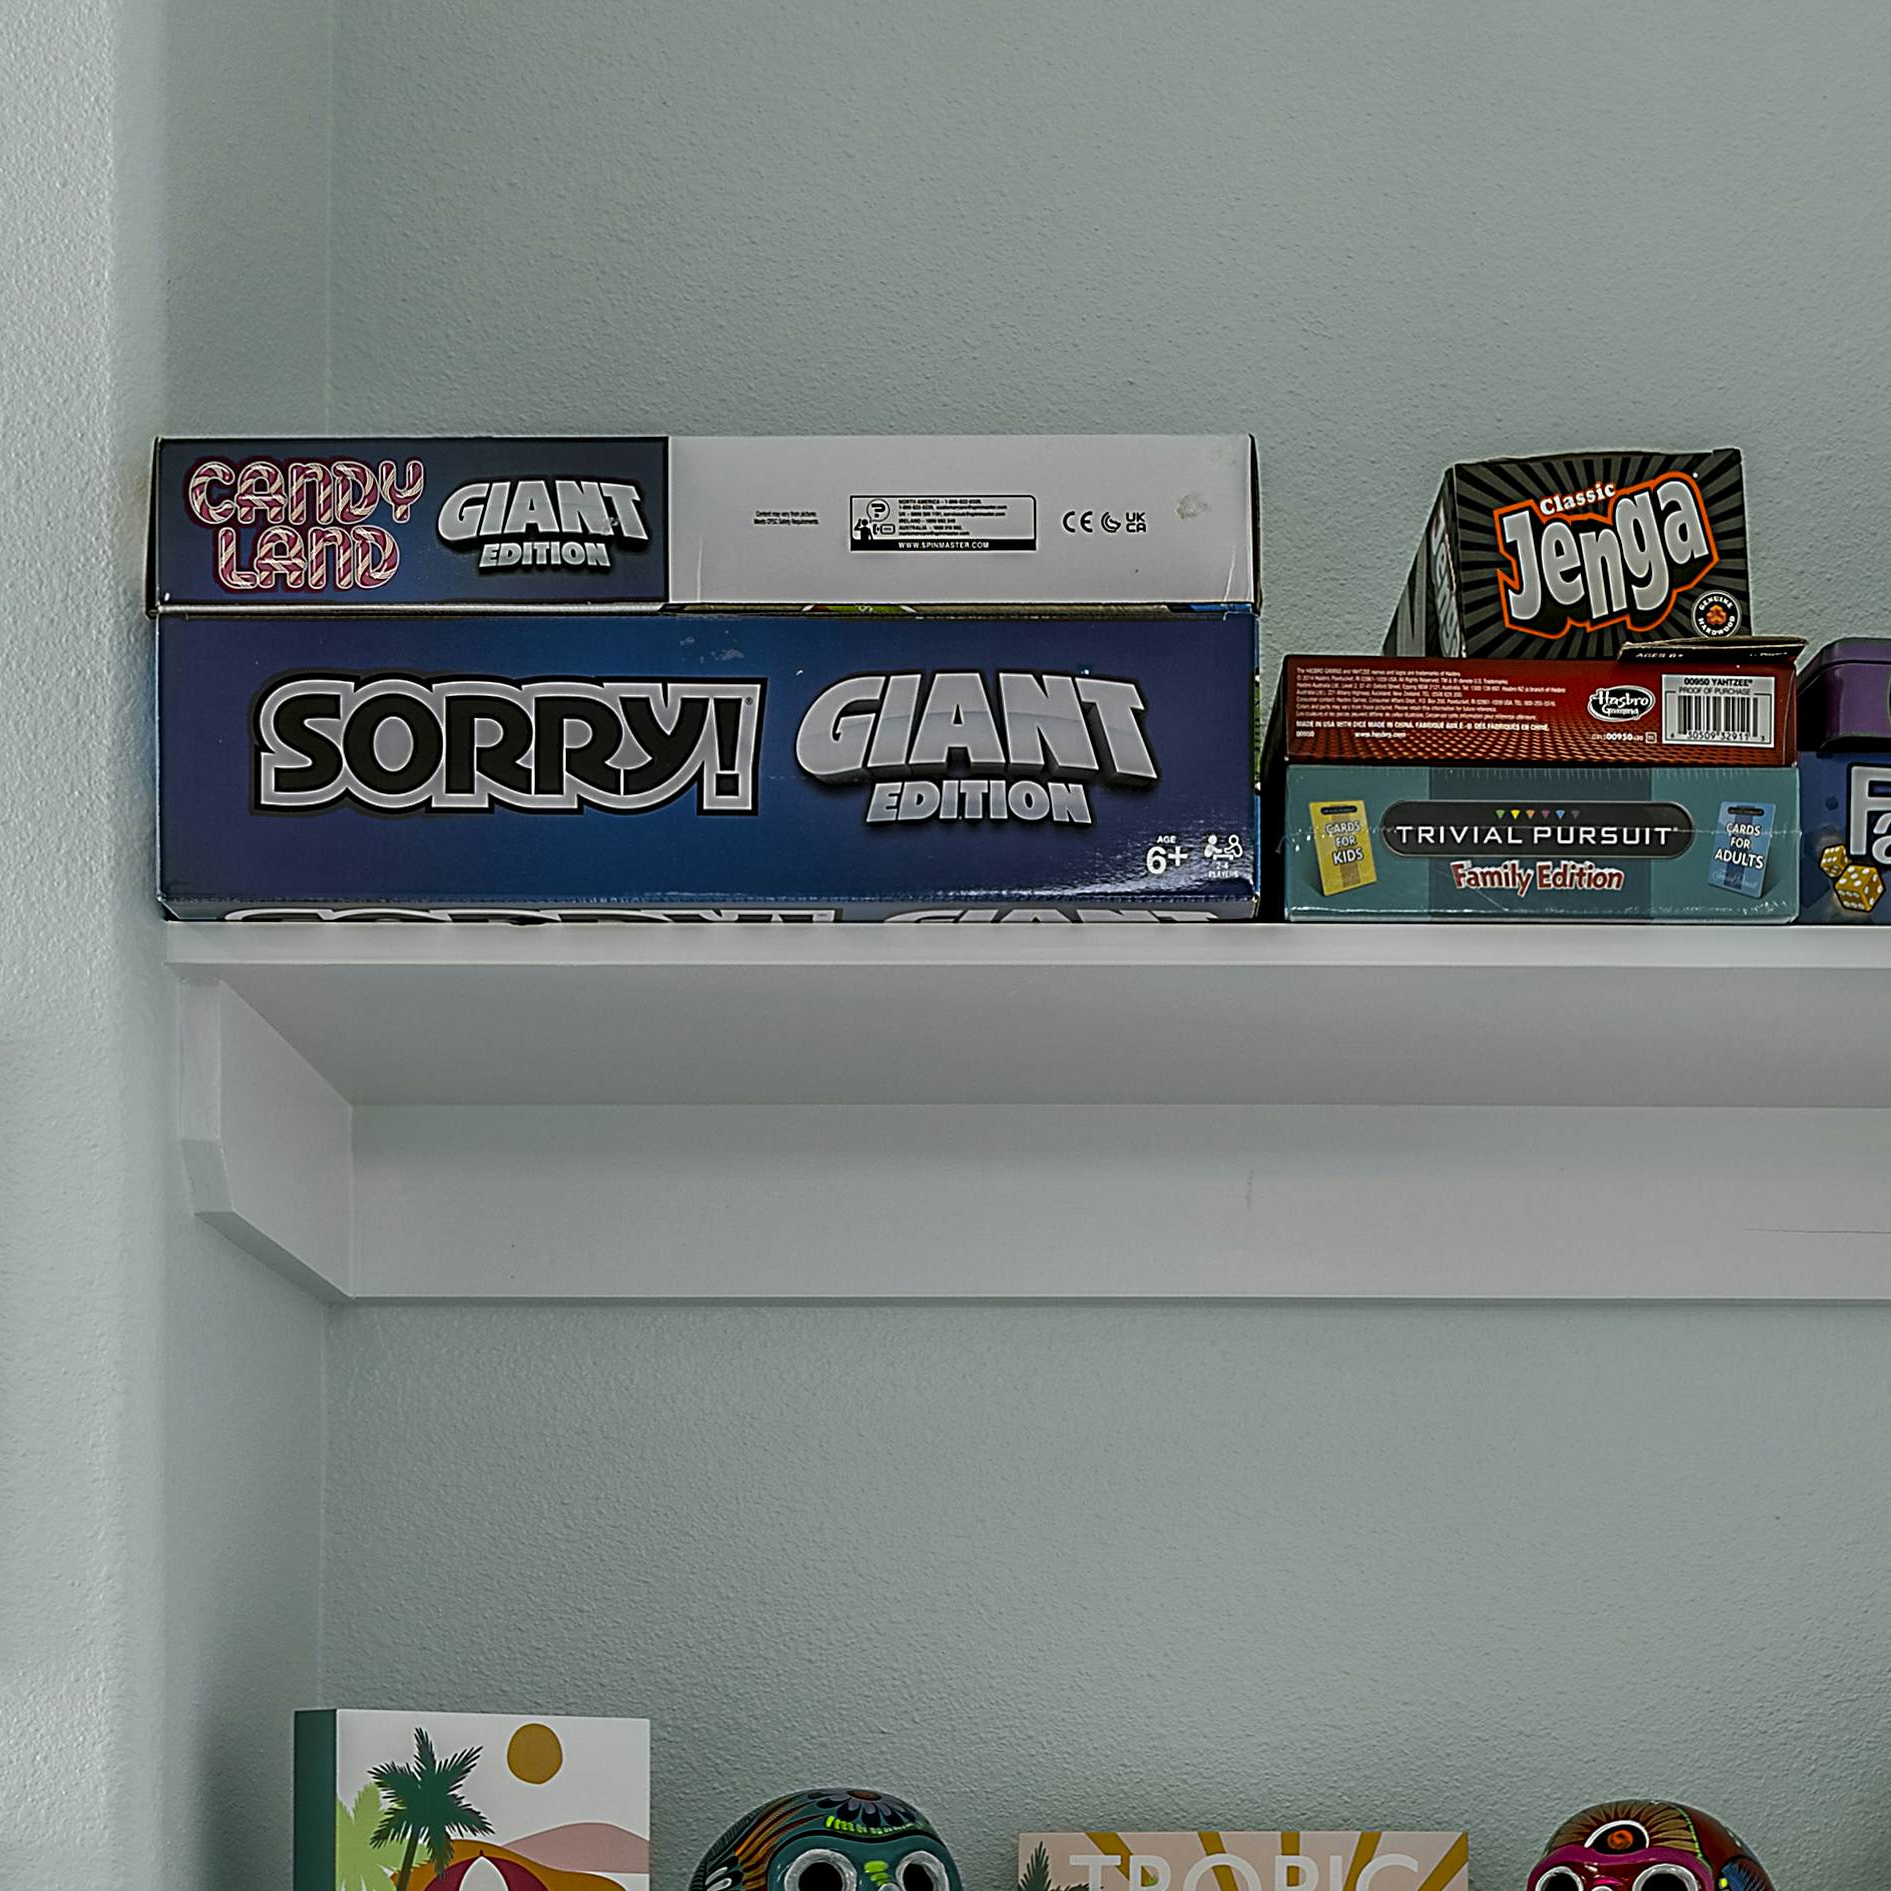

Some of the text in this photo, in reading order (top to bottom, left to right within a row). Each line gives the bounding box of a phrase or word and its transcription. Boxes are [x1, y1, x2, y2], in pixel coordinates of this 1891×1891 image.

[189, 459, 424, 524] CANDY
[1539, 482, 1616, 515] Classic
[438, 479, 649, 543] GIANT
[1125, 512, 1146, 522] UK
[1125, 522, 1147, 532] CA
[479, 541, 611, 568] EDITION
[898, 541, 990, 549] WWW.SPINMASTER.COM
[1502, 480, 1709, 621] Jenga
[218, 527, 400, 589] LAND
[1678, 686, 1702, 694] PROOF
[1714, 687, 1751, 696] PURCHASE
[1684, 677, 1710, 686] 00950
[1592, 689, 1649, 708] Hasbro
[795, 672, 1158, 779] GIANT
[261, 680, 761, 811] SORRY!
[866, 779, 1092, 824] EDITION
[1325, 821, 1361, 834] CARDS
[1395, 825, 1672, 846] TRIVIAL PURSUIT
[1726, 822, 1761, 837] CARDS
[1156, 835, 1177, 843] AGE
[1335, 835, 1357, 848] FOR
[1730, 836, 1751, 849] FOR
[1146, 845, 1189, 875] 6+
[1332, 847, 1364, 865] KIDS
[1714, 848, 1764, 869] ADULTS
[1450, 859, 1625, 897] Family Edition
